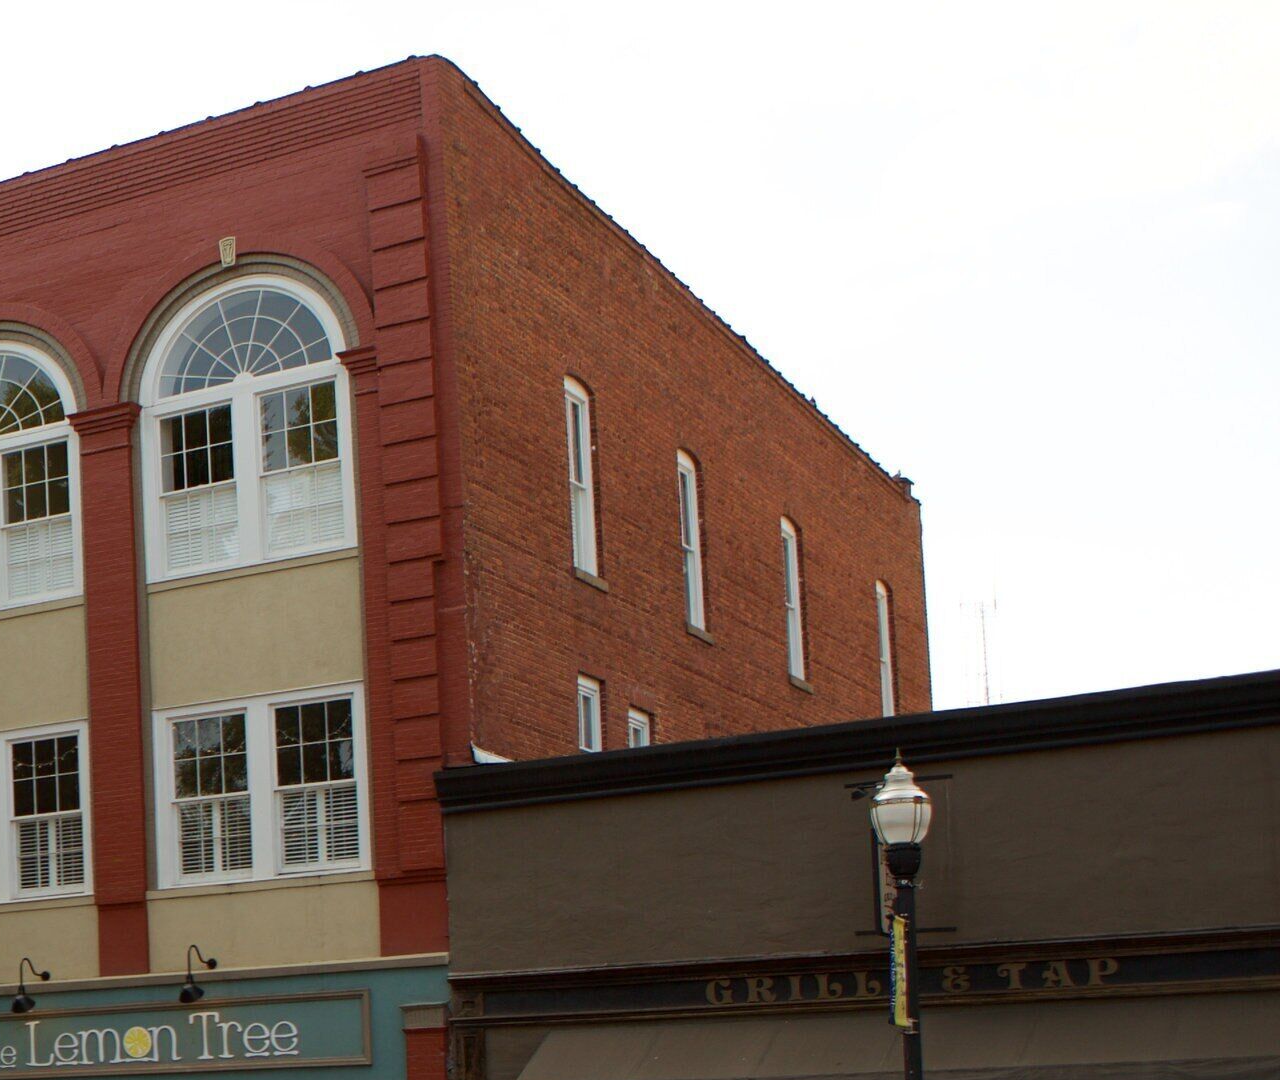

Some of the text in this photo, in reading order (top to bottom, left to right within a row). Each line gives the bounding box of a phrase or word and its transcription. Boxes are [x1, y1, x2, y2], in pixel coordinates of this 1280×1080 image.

[705, 957, 1120, 1006] GRILL & TAP
[25, 1020, 181, 1067] Lemon
[189, 1011, 300, 1060] Tree
